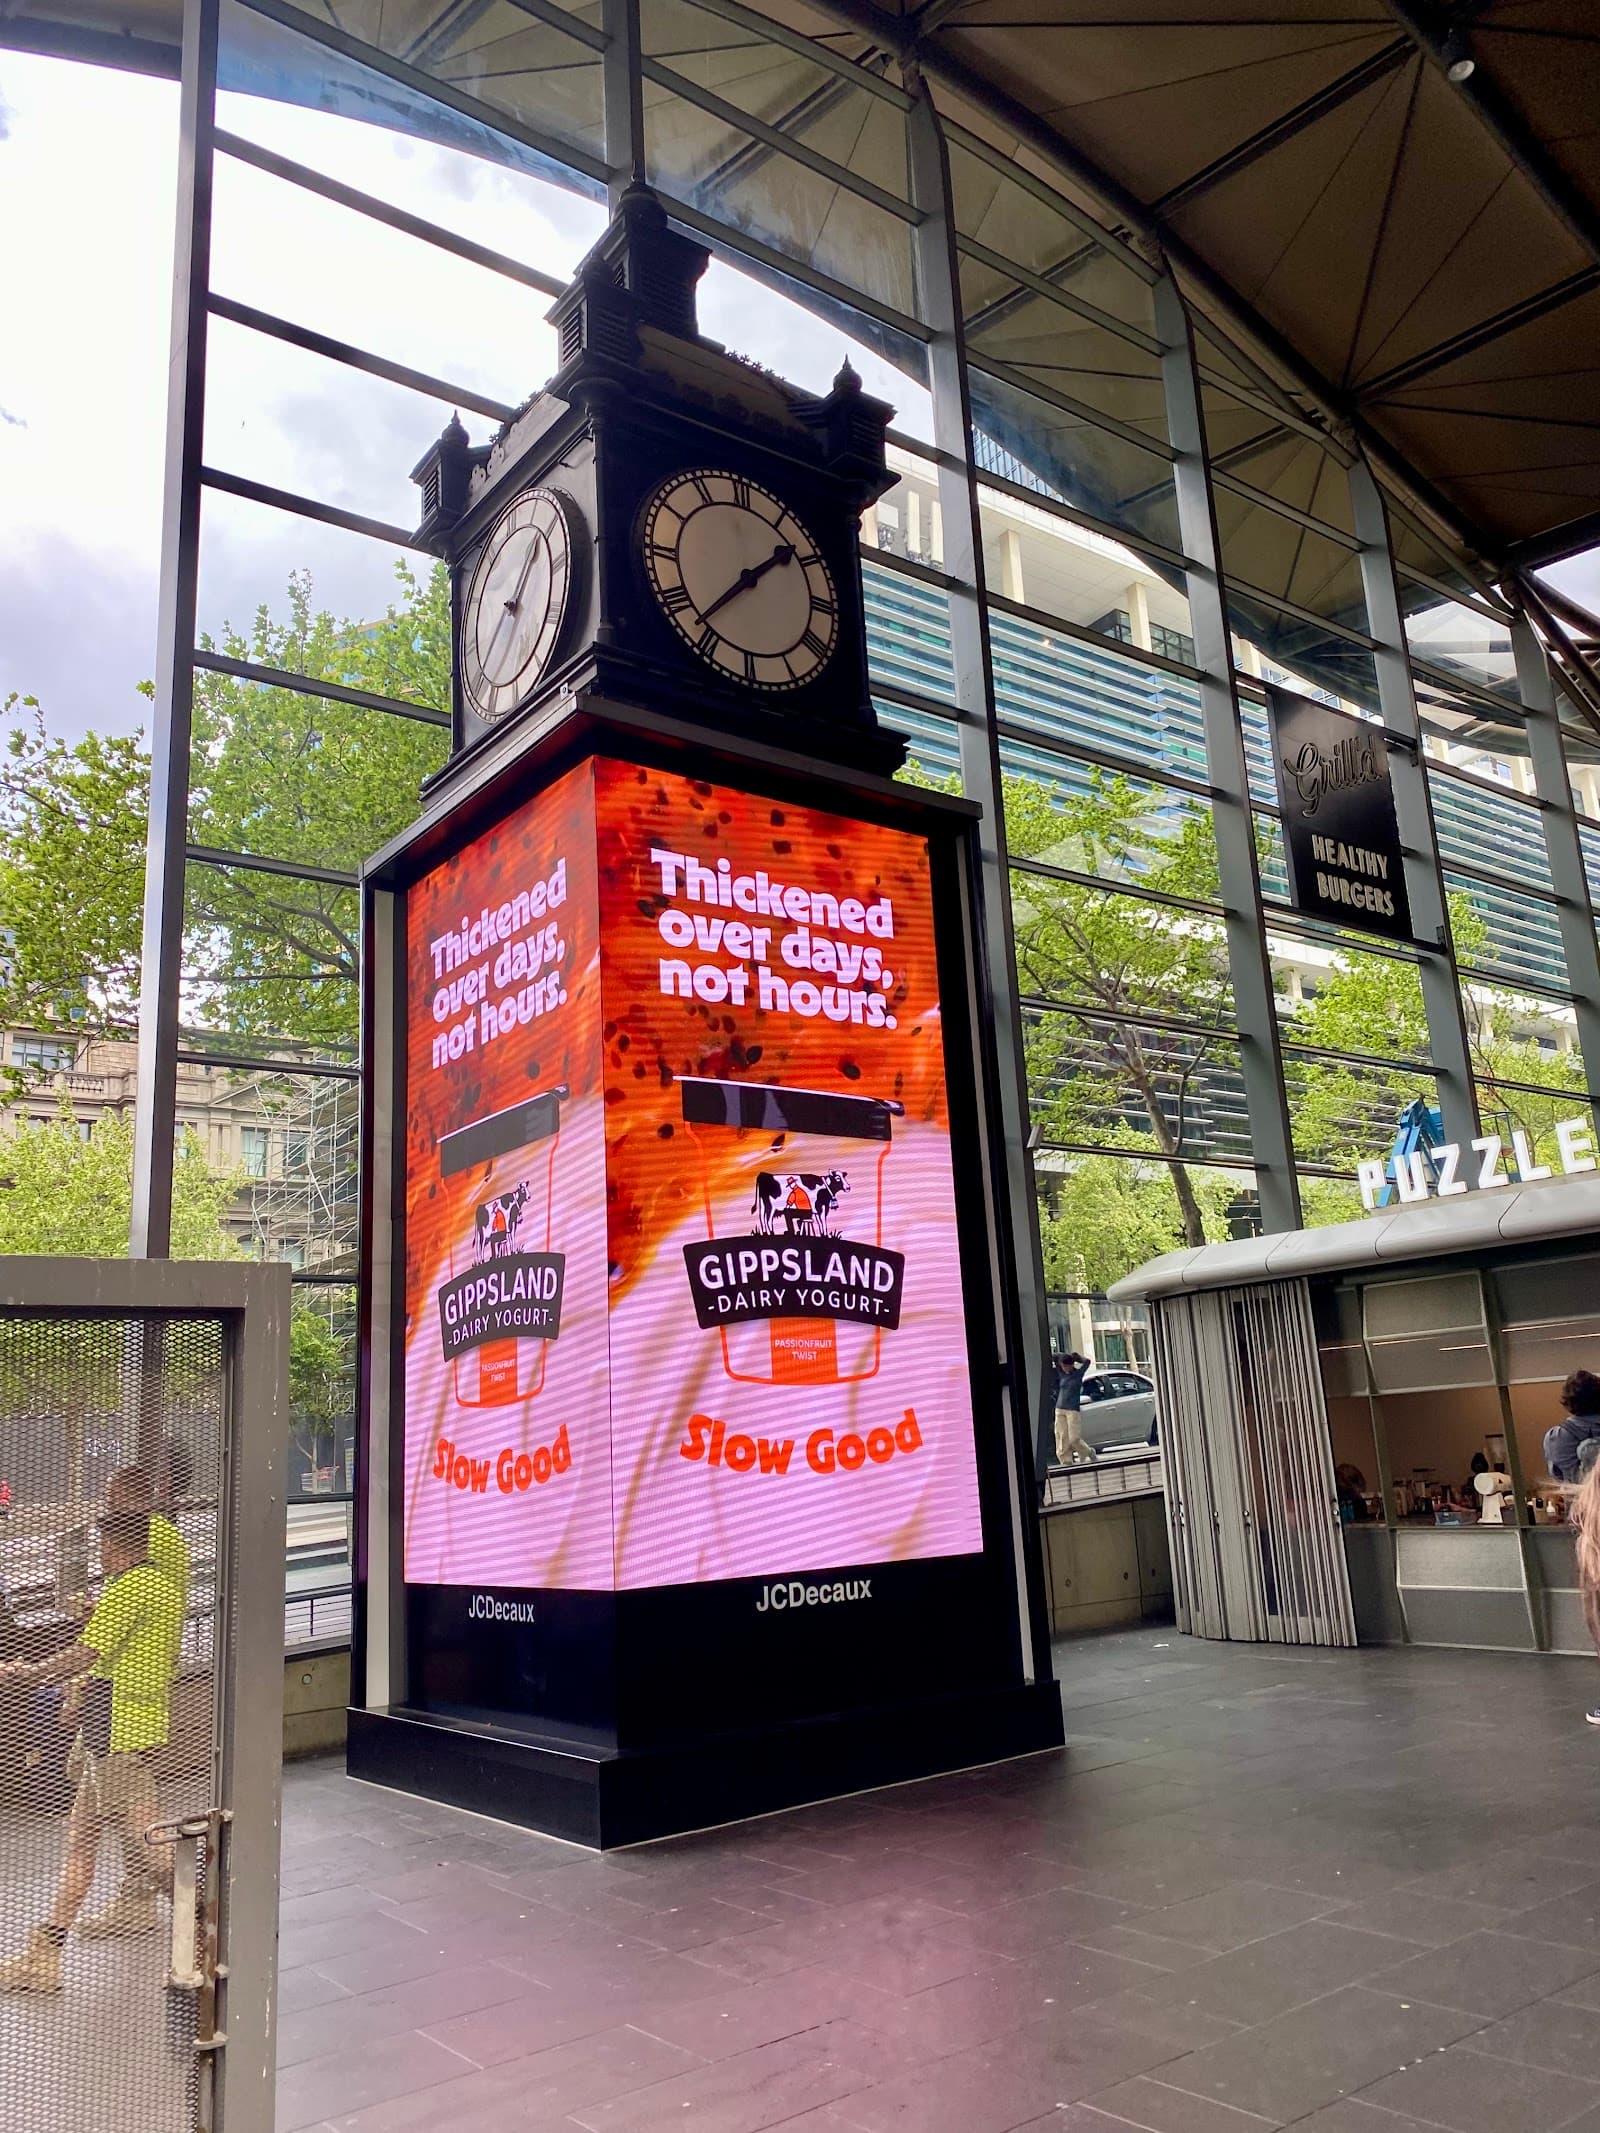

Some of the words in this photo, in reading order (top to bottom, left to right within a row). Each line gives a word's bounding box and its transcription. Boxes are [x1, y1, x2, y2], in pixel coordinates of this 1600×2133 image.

[1283, 735, 1382, 818] Grill'd
[1311, 833, 1388, 880] HEALTHY
[430, 857, 567, 980] Thickened
[650, 847, 894, 939] Thickened
[1316, 871, 1395, 917] BURGERS
[658, 909, 771, 961] over
[432, 961, 489, 1023] over
[432, 1010, 476, 1070] not
[480, 970, 568, 1045] hours.
[659, 957, 749, 1006] not
[758, 965, 898, 1030] hours.
[1357, 1117, 1597, 1209] PUZZLE
[445, 1266, 558, 1325] GIPPSLAND
[699, 1248, 895, 1293] GIPPSLAND
[774, 1339, 833, 1349] PASSIONFRUIT
[791, 1351, 817, 1360] TWIST
[433, 1438, 490, 1494] Slow
[497, 1423, 572, 1494] Good
[680, 1413, 795, 1475] Slow
[806, 1408, 923, 1474] Good
[468, 1594, 535, 1623] JCDecaux
[756, 1579, 873, 1612] JCDecaux
